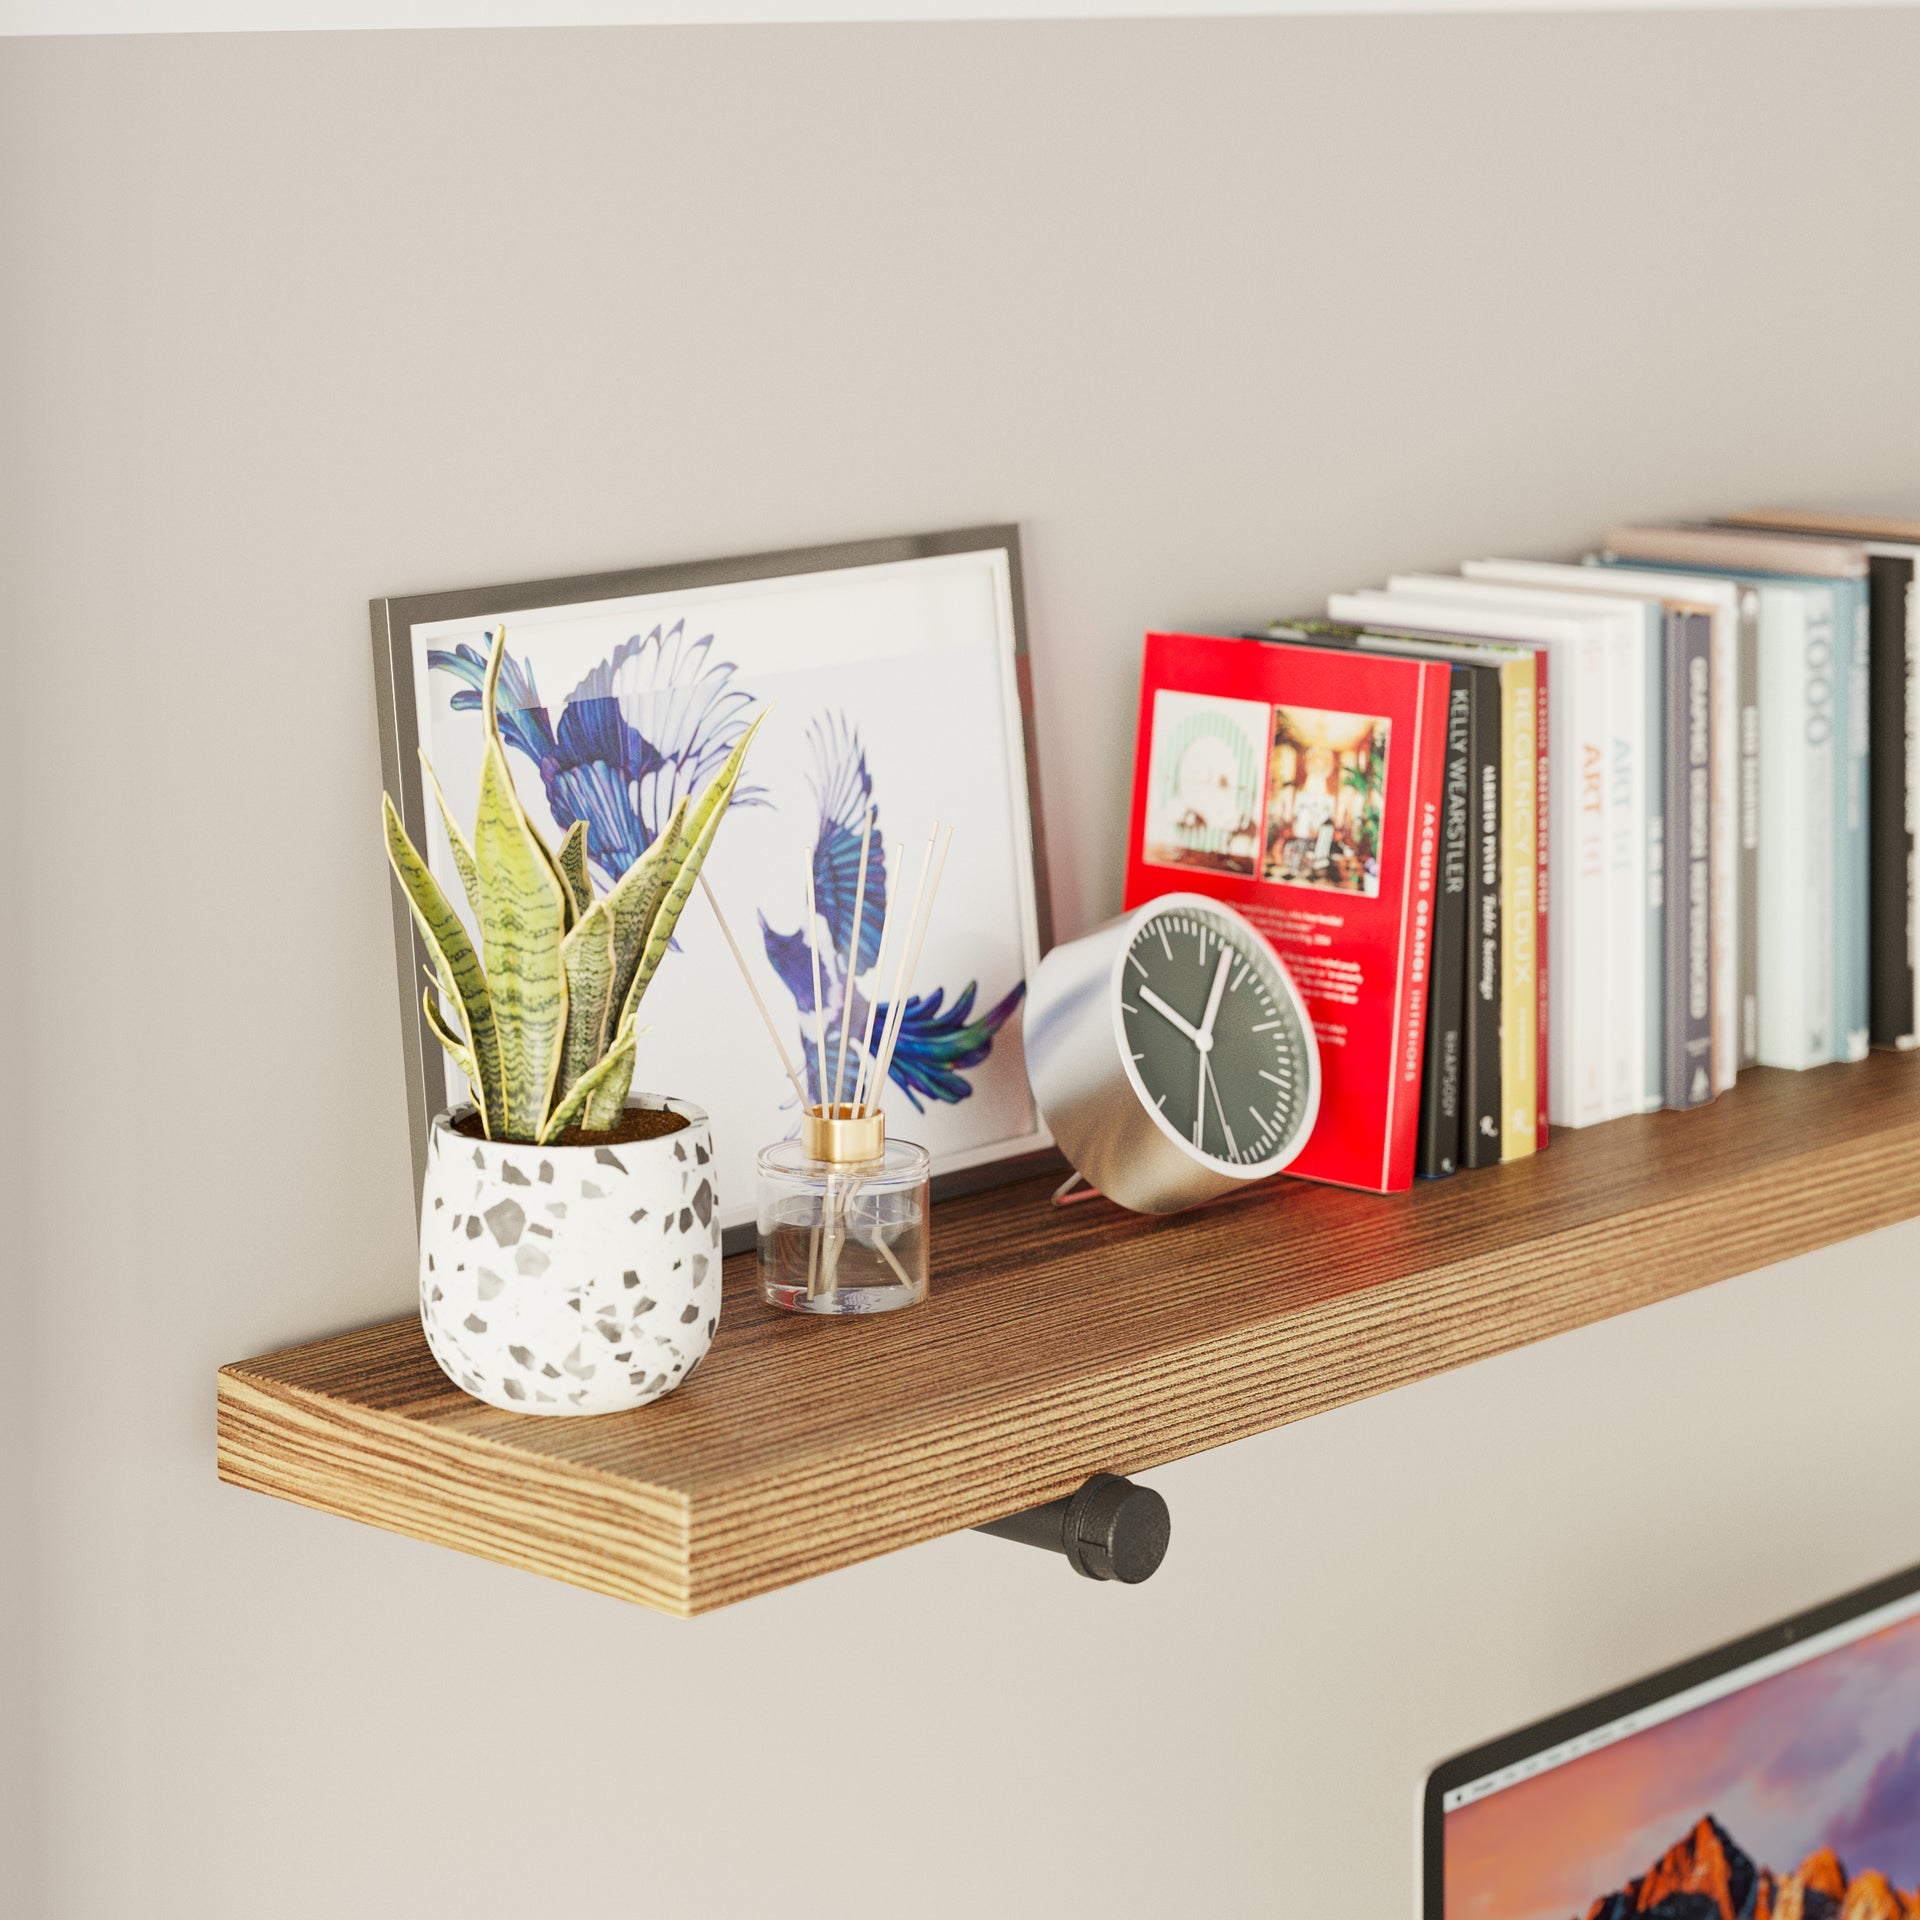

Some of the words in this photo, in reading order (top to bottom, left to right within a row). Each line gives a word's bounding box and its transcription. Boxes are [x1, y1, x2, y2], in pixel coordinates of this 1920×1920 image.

[1450, 688, 1469, 754] KELLY
[1689, 656, 1709, 766] GRAPHIC
[1804, 610, 1832, 748] 1000
[1482, 765, 1497, 834] ALBERTO
[1513, 687, 1533, 856] REGENCY
[1583, 742, 1603, 816] ART
[1613, 737, 1632, 808] ART
[1688, 767, 1708, 859] DESIGN
[1418, 801, 1436, 892] JACQUES
[1445, 757, 1468, 894] WEARSTLER
[1482, 836, 1496, 886] PINTO
[1412, 899, 1429, 983] GRANGE
[1482, 893, 1497, 935] Table
[1512, 866, 1532, 986] REDUX
[1478, 938, 1497, 1001] Settings
[1404, 989, 1422, 1083] INTERIORS
[1442, 1030, 1458, 1118] RHAPSODY
